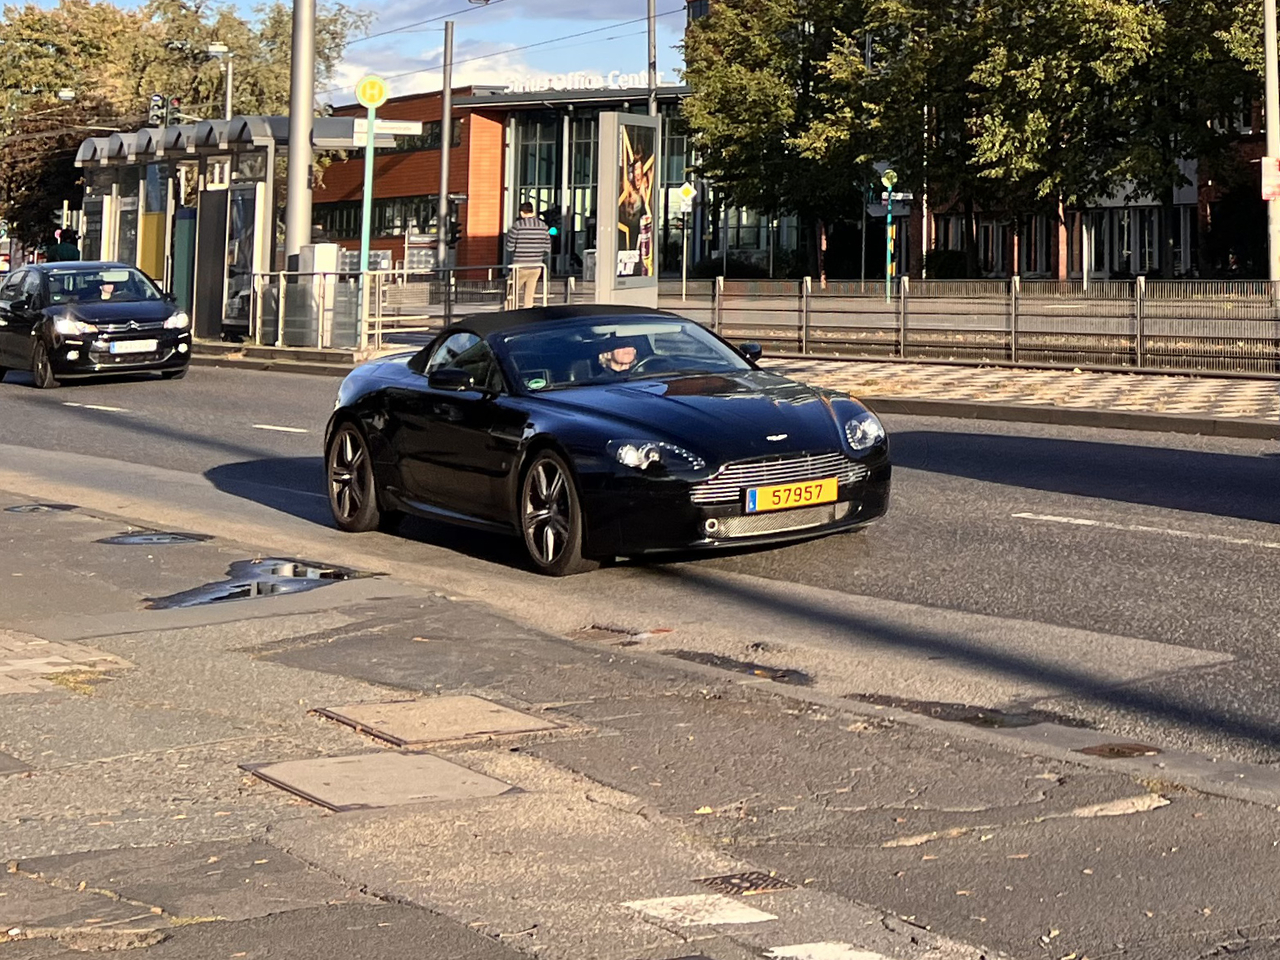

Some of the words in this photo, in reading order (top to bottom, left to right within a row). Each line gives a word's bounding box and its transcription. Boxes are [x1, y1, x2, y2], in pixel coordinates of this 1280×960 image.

[550, 71, 603, 90] Office
[366, 83, 380, 100] H
[772, 484, 823, 505] 57957
